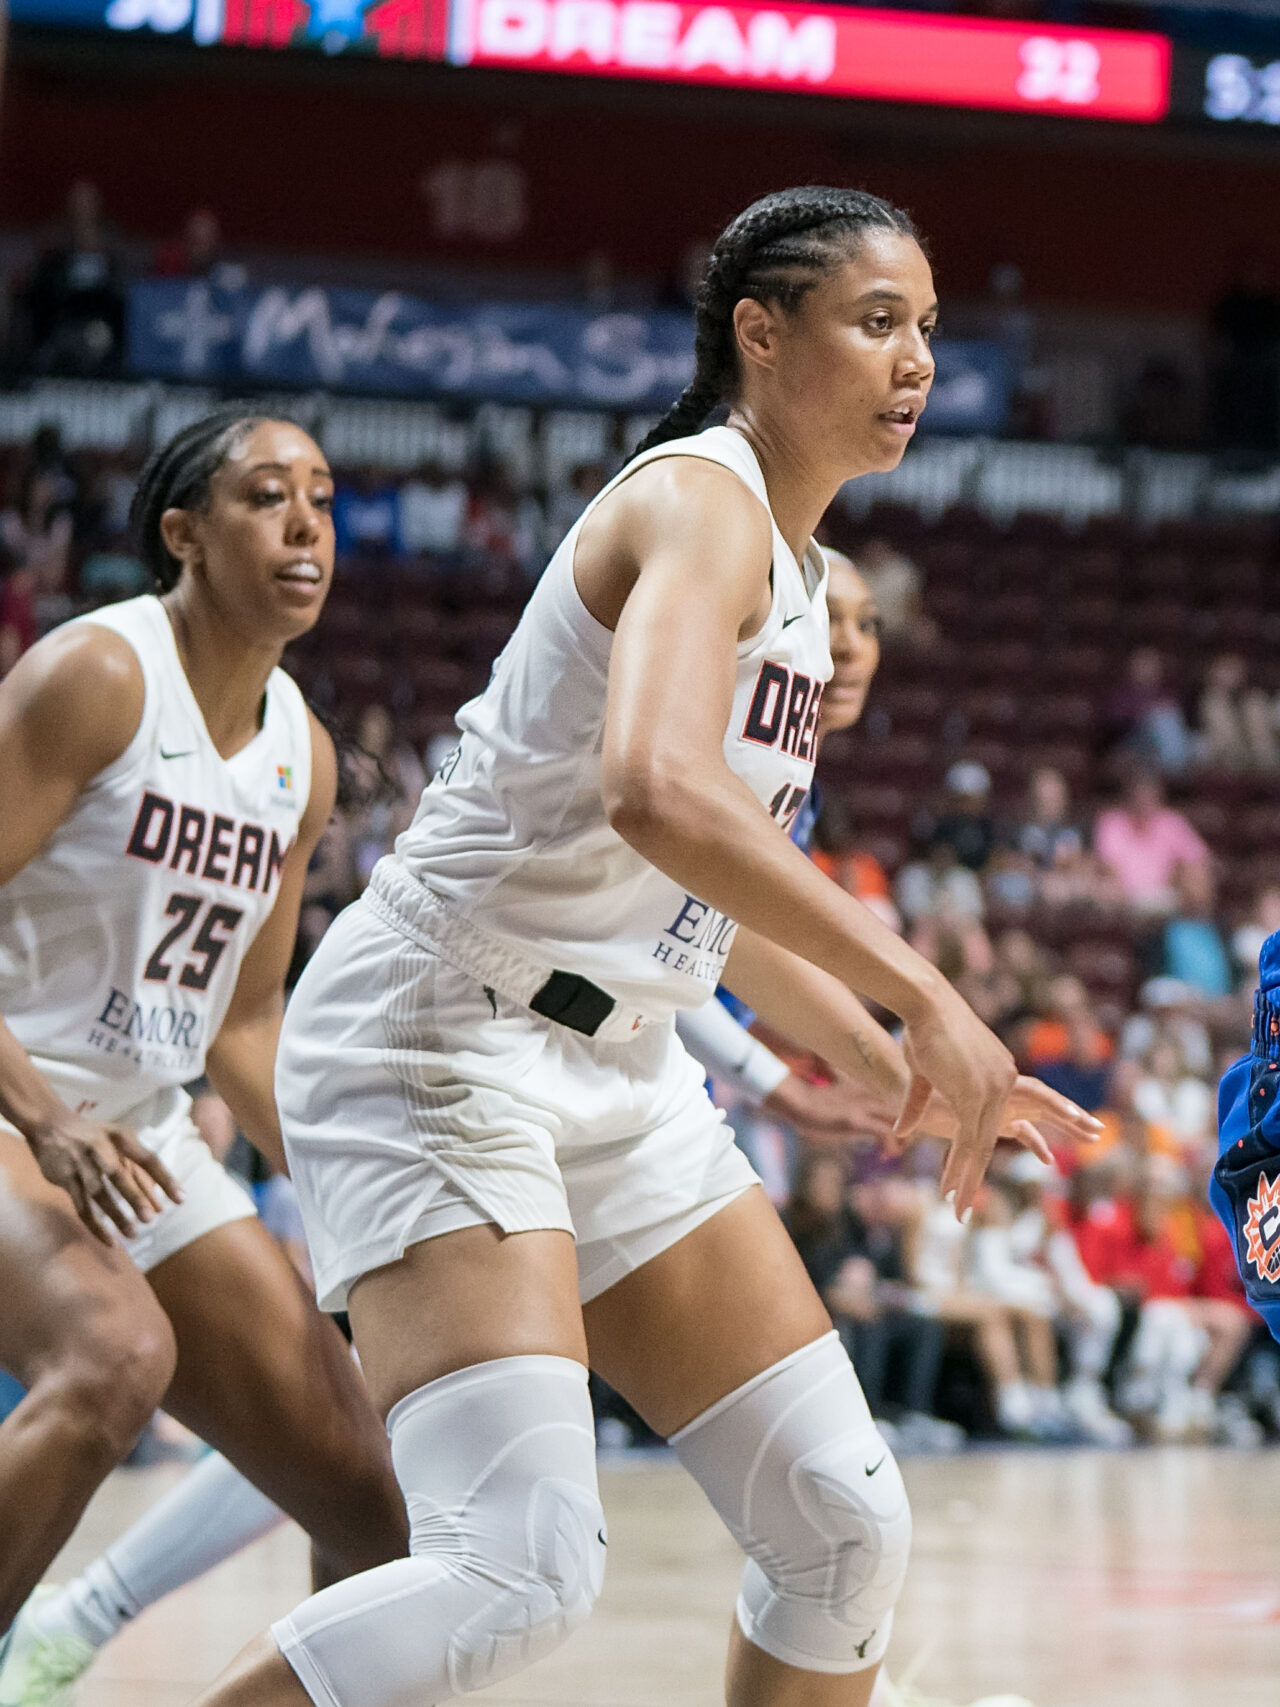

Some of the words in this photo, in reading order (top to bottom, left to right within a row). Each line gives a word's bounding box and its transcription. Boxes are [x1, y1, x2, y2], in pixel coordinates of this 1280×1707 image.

[480, 0, 836, 82] DREAM
[143, 893, 243, 991] 25
[97, 986, 201, 1049] EMOR
